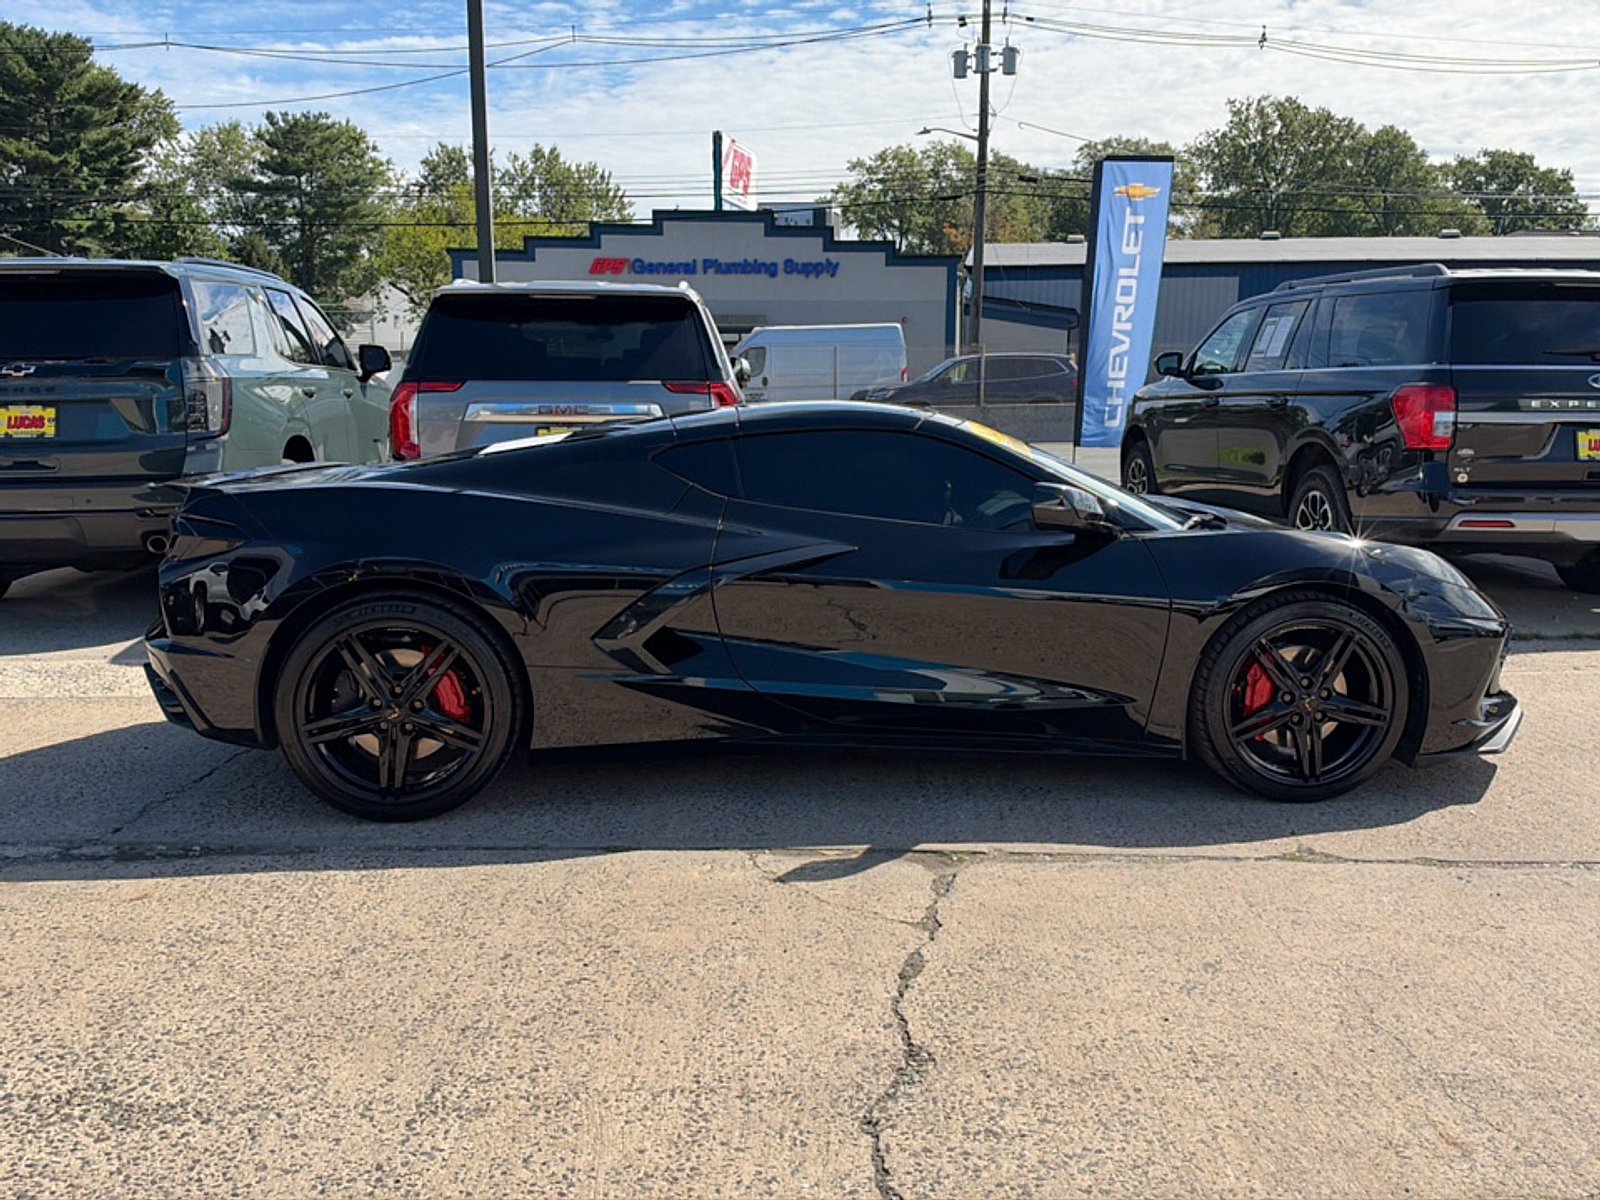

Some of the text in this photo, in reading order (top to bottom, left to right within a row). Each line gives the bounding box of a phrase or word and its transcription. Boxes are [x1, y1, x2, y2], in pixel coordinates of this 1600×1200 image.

[631, 257, 697, 274] General
[702, 258, 778, 278] Plumbing
[783, 258, 840, 278] Supply
[1104, 206, 1146, 428] CHEVROLET
[538, 405, 589, 415] GMC
[7, 415, 46, 429] LUCAS
